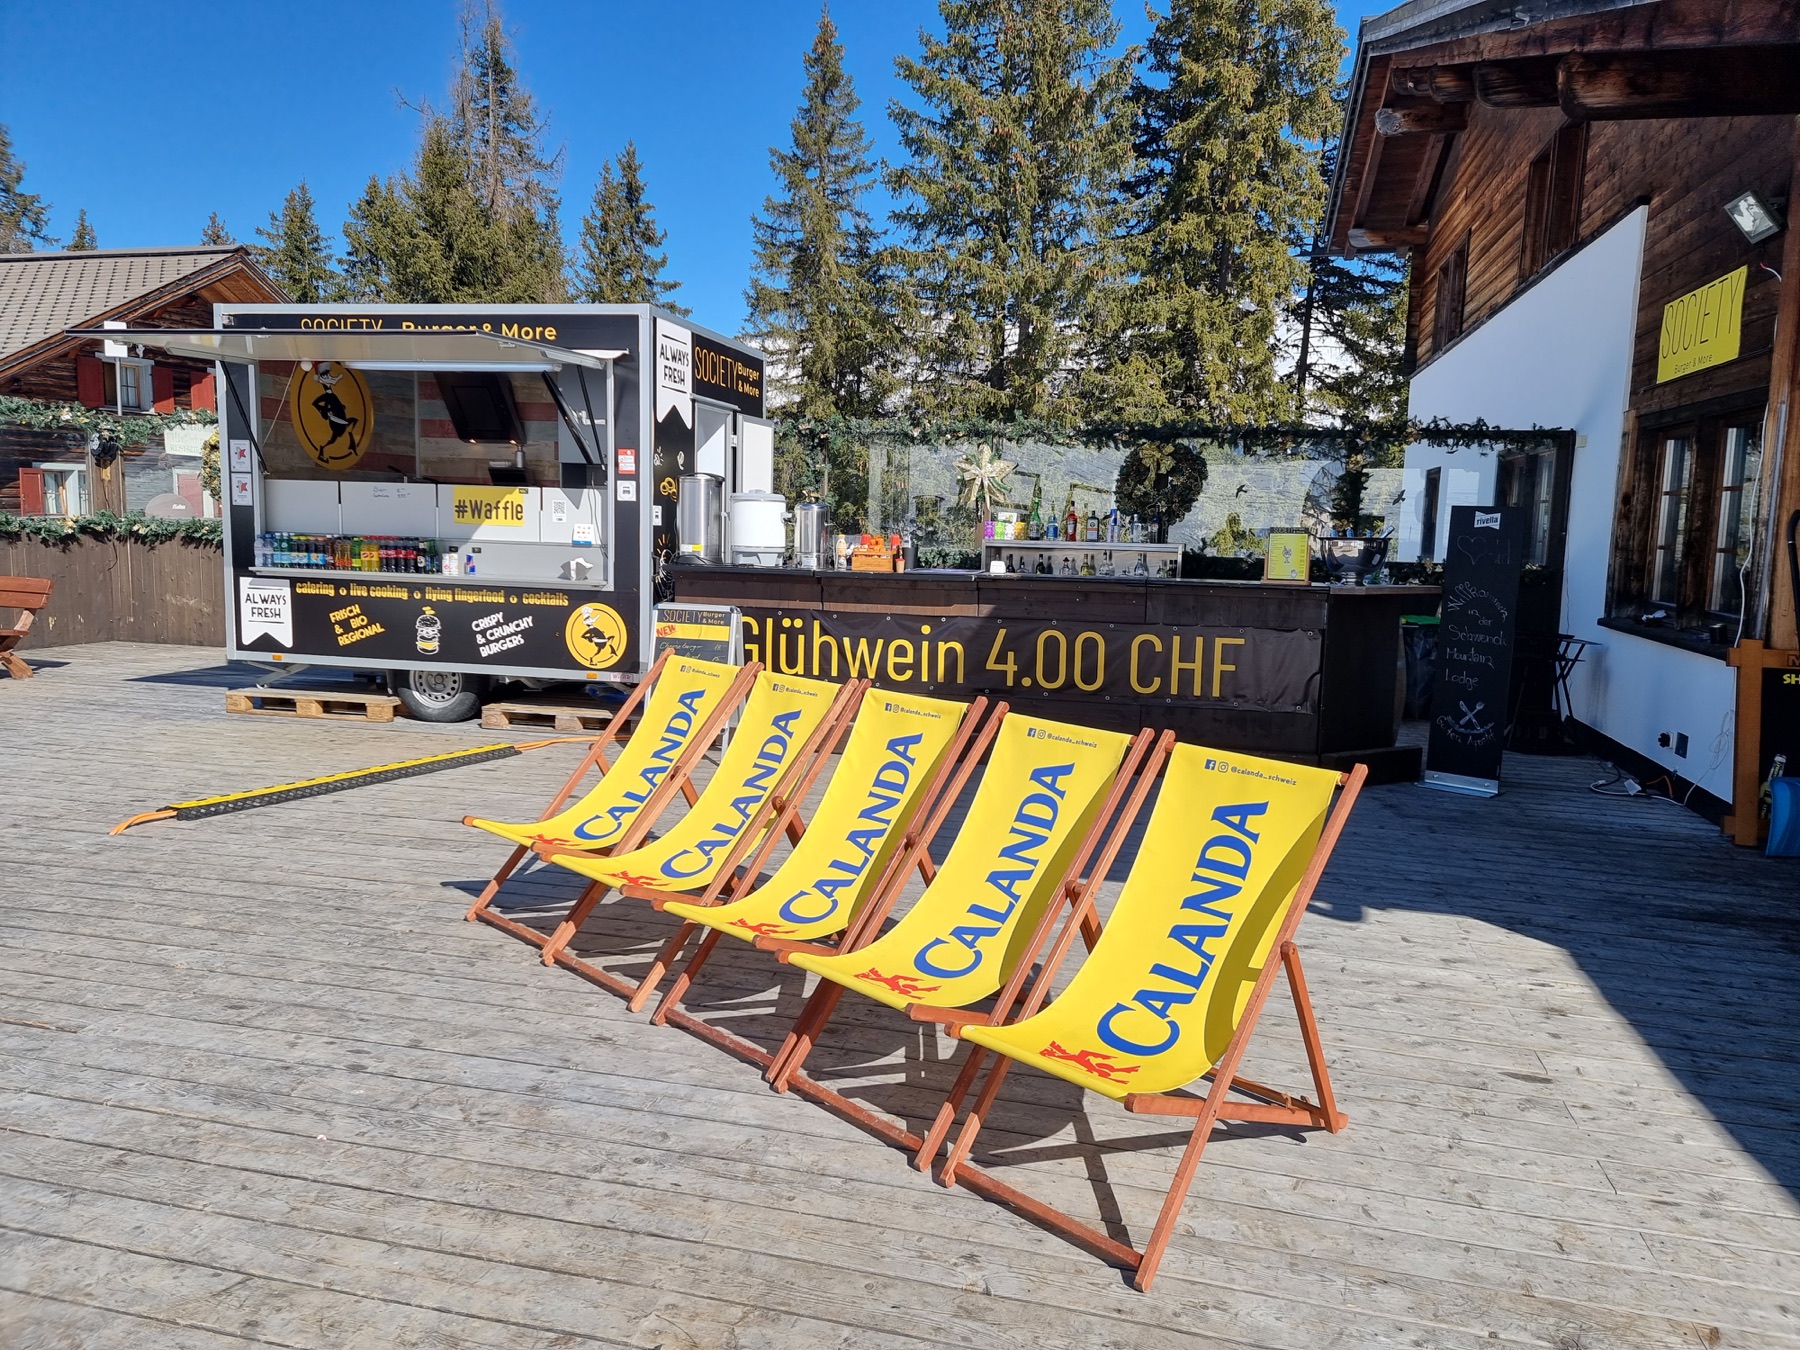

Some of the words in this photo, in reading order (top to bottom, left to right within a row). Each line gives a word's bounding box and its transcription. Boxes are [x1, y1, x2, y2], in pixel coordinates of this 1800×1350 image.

[1661, 271, 1745, 359] SOCIETY
[501, 323, 557, 341] More
[660, 343, 689, 367] ALWAYS
[663, 365, 685, 386] FRESH
[694, 346, 738, 390] SOCIETY
[738, 363, 760, 381] Burger
[738, 380, 743, 393] &
[743, 381, 760, 398] More
[454, 499, 524, 521] #Waffle
[1476, 515, 1499, 526] rivella
[245, 593, 287, 606] ALWAYS
[295, 582, 335, 597] catering
[350, 583, 368, 597] live
[369, 584, 409, 600] cooking
[425, 586, 453, 603] flying
[454, 588, 505, 604] fingerfood
[522, 592, 569, 606] cocktails
[251, 607, 282, 619] FRESH
[328, 604, 361, 624] FRISCH
[471, 611, 505, 632] CRISPY
[663, 610, 703, 623] SOCIETY
[334, 624, 344, 635] &
[350, 615, 368, 628] BIO
[337, 622, 386, 647] REGIONAL
[475, 634, 486, 645] &
[488, 615, 534, 641] CRUNCHY
[656, 624, 676, 637] NEW
[478, 634, 525, 658] BURGERS
[985, 628, 1106, 691] 4.00
[1130, 633, 1246, 697] CHF
[1047, 732, 1098, 748] @calanda_schweiz
[573, 688, 706, 841] CALANDA
[1230, 765, 1297, 786] @calanda_schweiz
[659, 709, 803, 878] CALANDA
[779, 732, 923, 925] CALANDA
[913, 761, 1075, 979] CALANDA
[1096, 800, 1269, 1057] CALANDA
